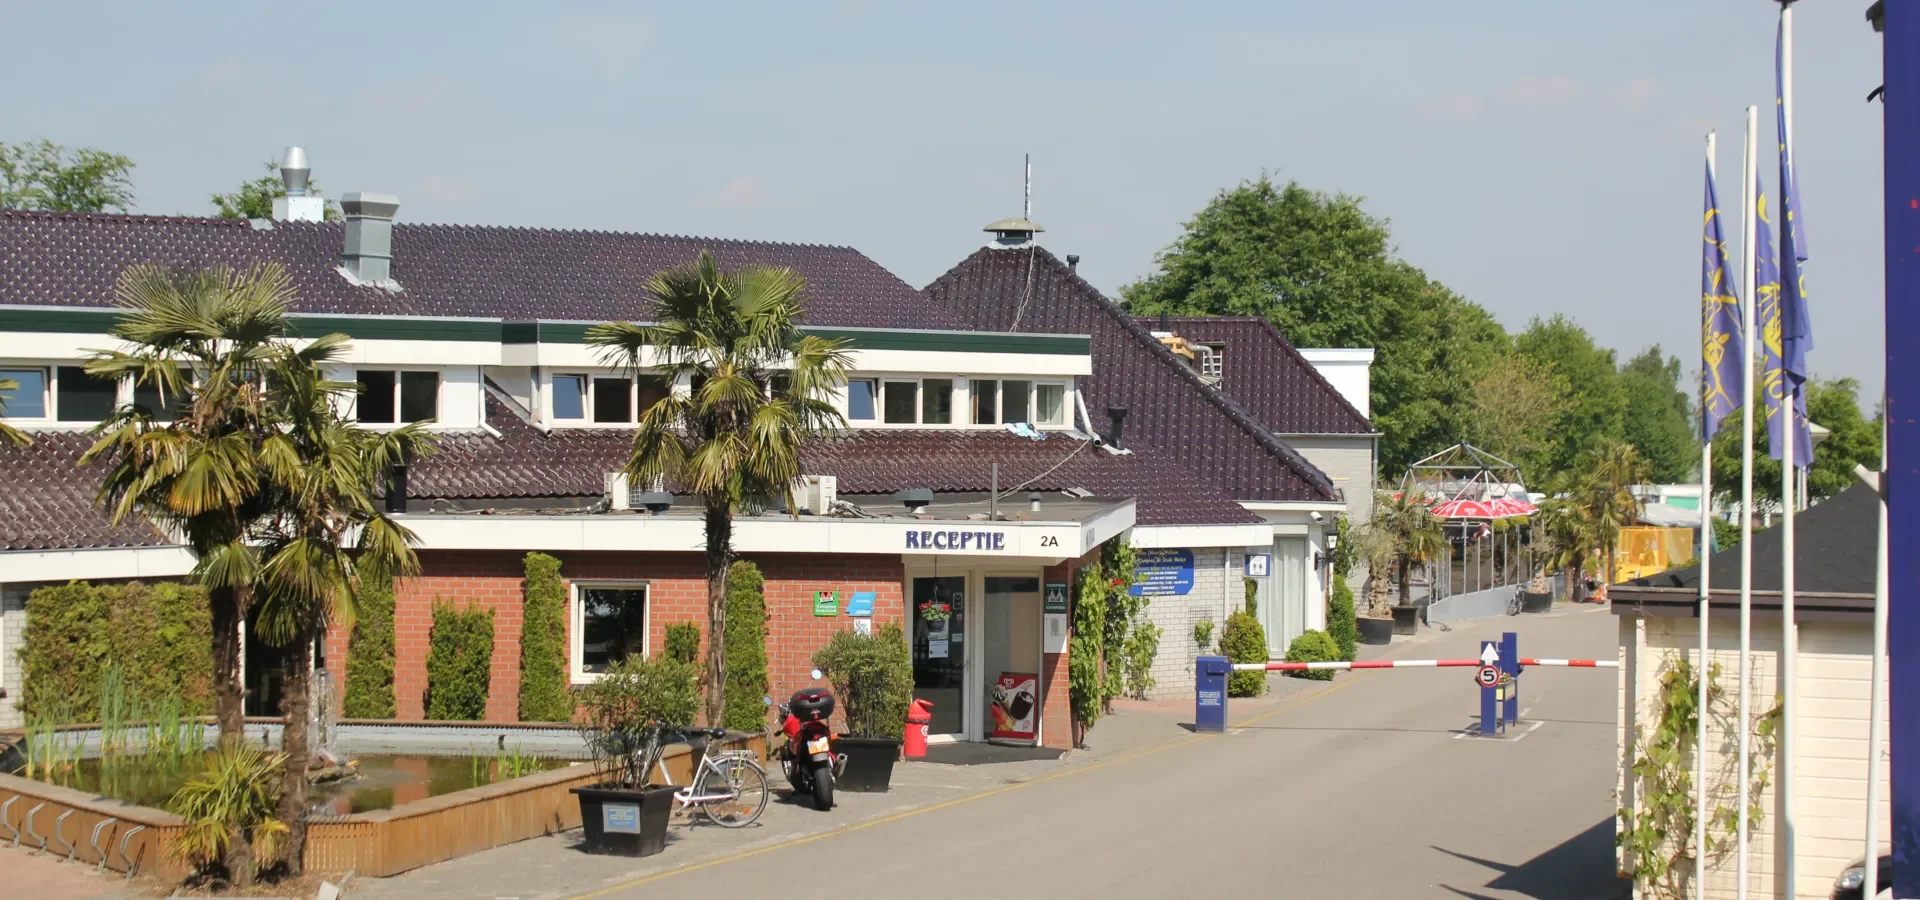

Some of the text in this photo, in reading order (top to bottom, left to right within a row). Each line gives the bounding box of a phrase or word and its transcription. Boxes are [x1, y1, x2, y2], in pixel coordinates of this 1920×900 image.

[906, 530, 1005, 550] RECEPTIE
[1040, 535, 1059, 547] 2A
[1483, 670, 1495, 682] 5
